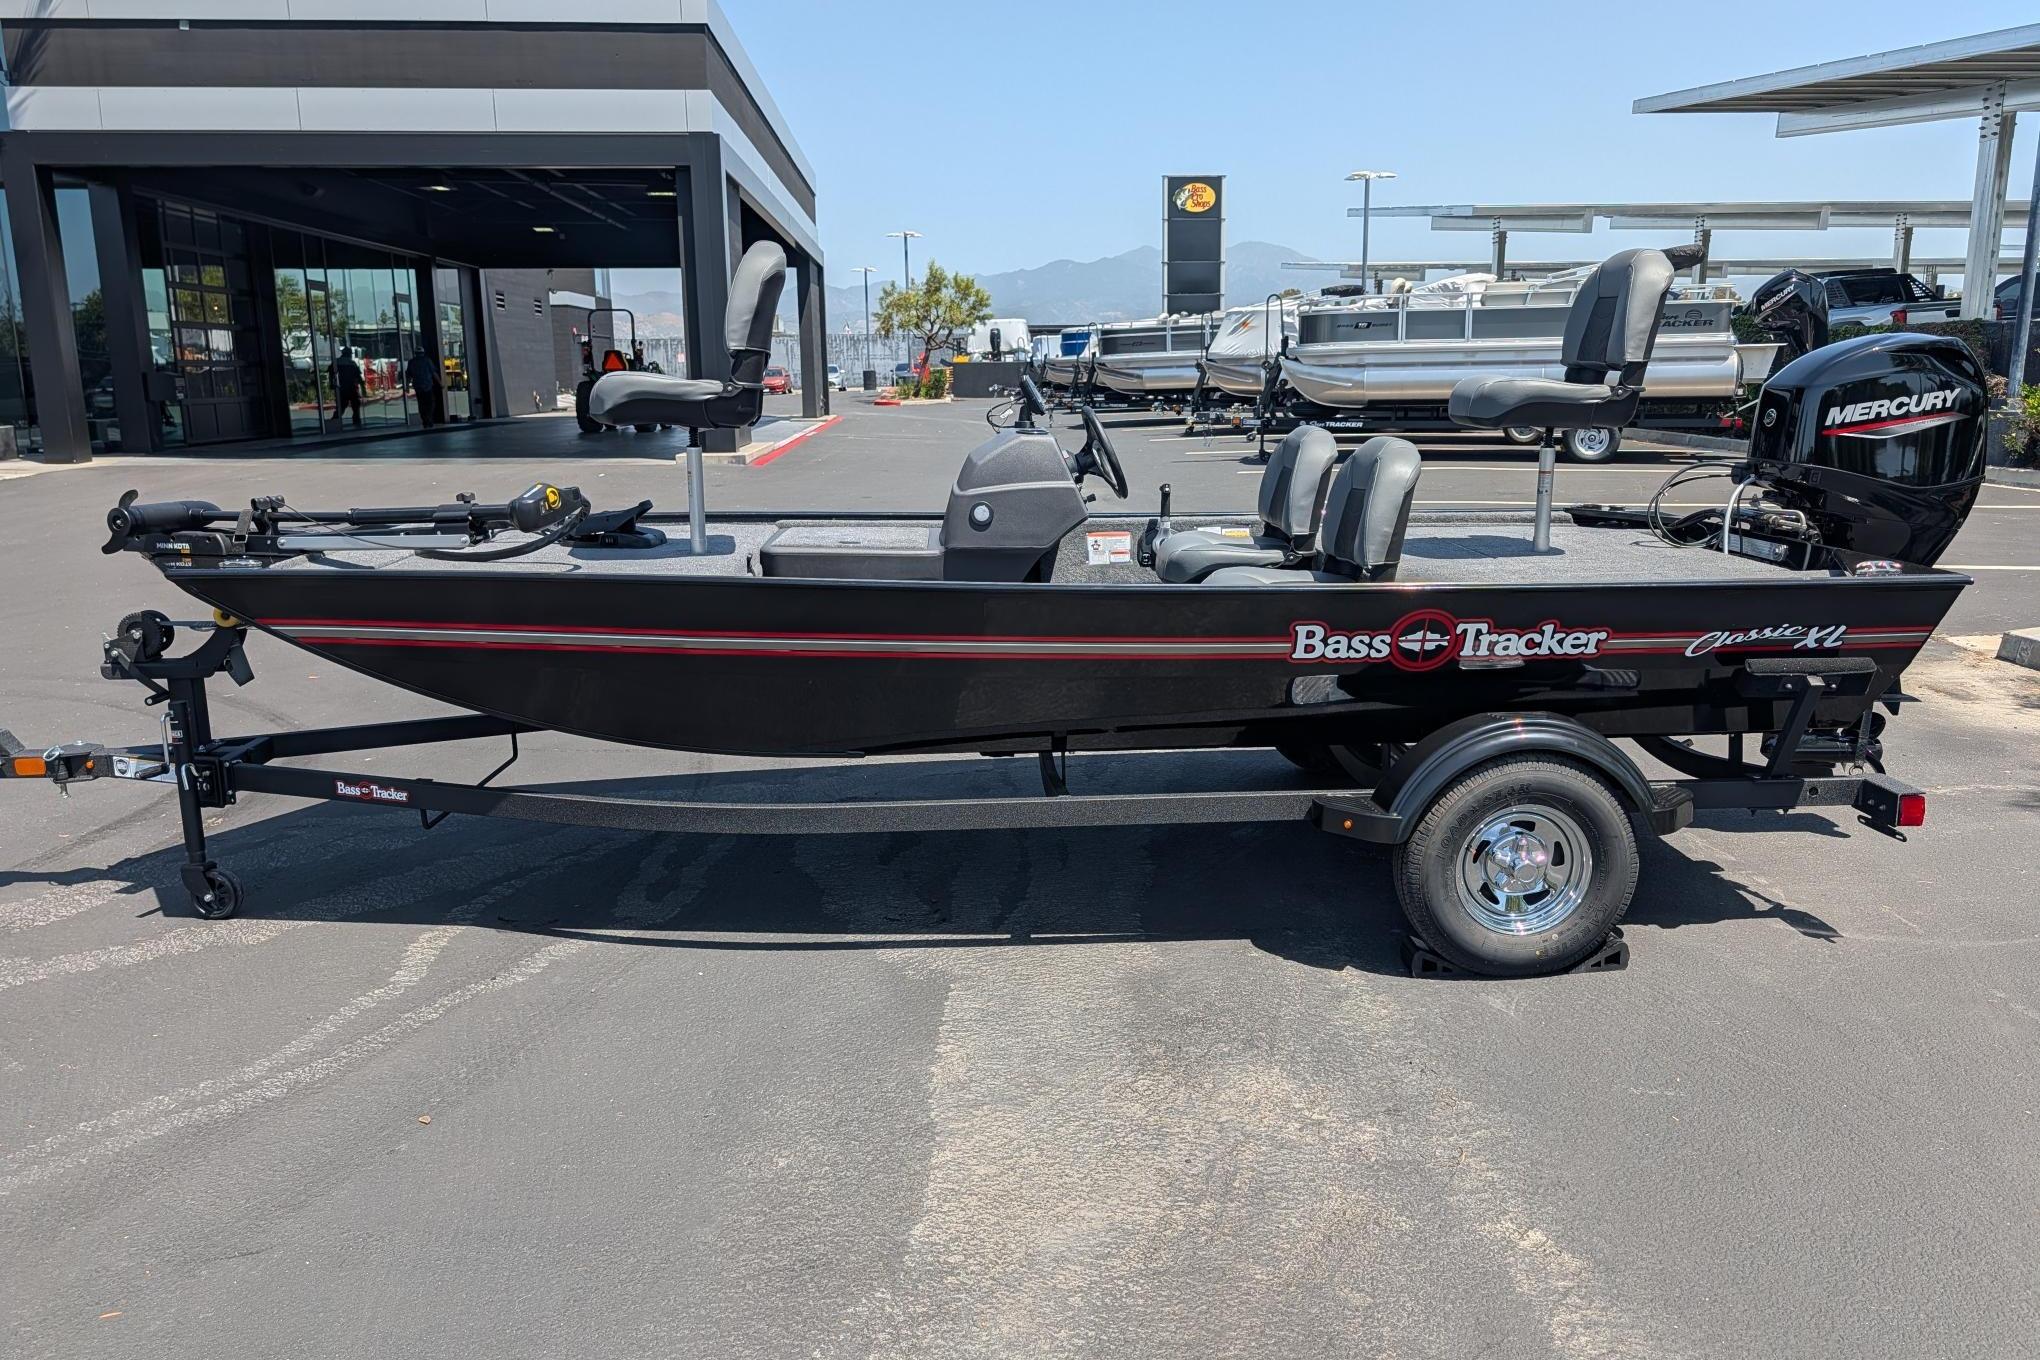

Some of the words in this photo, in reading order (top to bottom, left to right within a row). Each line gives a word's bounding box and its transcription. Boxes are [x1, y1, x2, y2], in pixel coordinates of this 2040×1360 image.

[1191, 184, 1207, 193] Bass
[1191, 191, 1204, 201] Pro
[1191, 200, 1211, 209] Shops
[1760, 283, 1795, 311] MERCURY
[1662, 319, 1714, 328] ACKER
[1824, 387, 1962, 426] MERCURY
[156, 542, 174, 550] MINN
[173, 542, 191, 550] KOTA
[1291, 624, 1392, 659] Bass
[1455, 622, 1608, 657] Tracker
[1684, 623, 1808, 657] Classic
[1793, 624, 1848, 650] XL
[336, 781, 361, 796] Bass
[370, 785, 408, 801] Tracker
